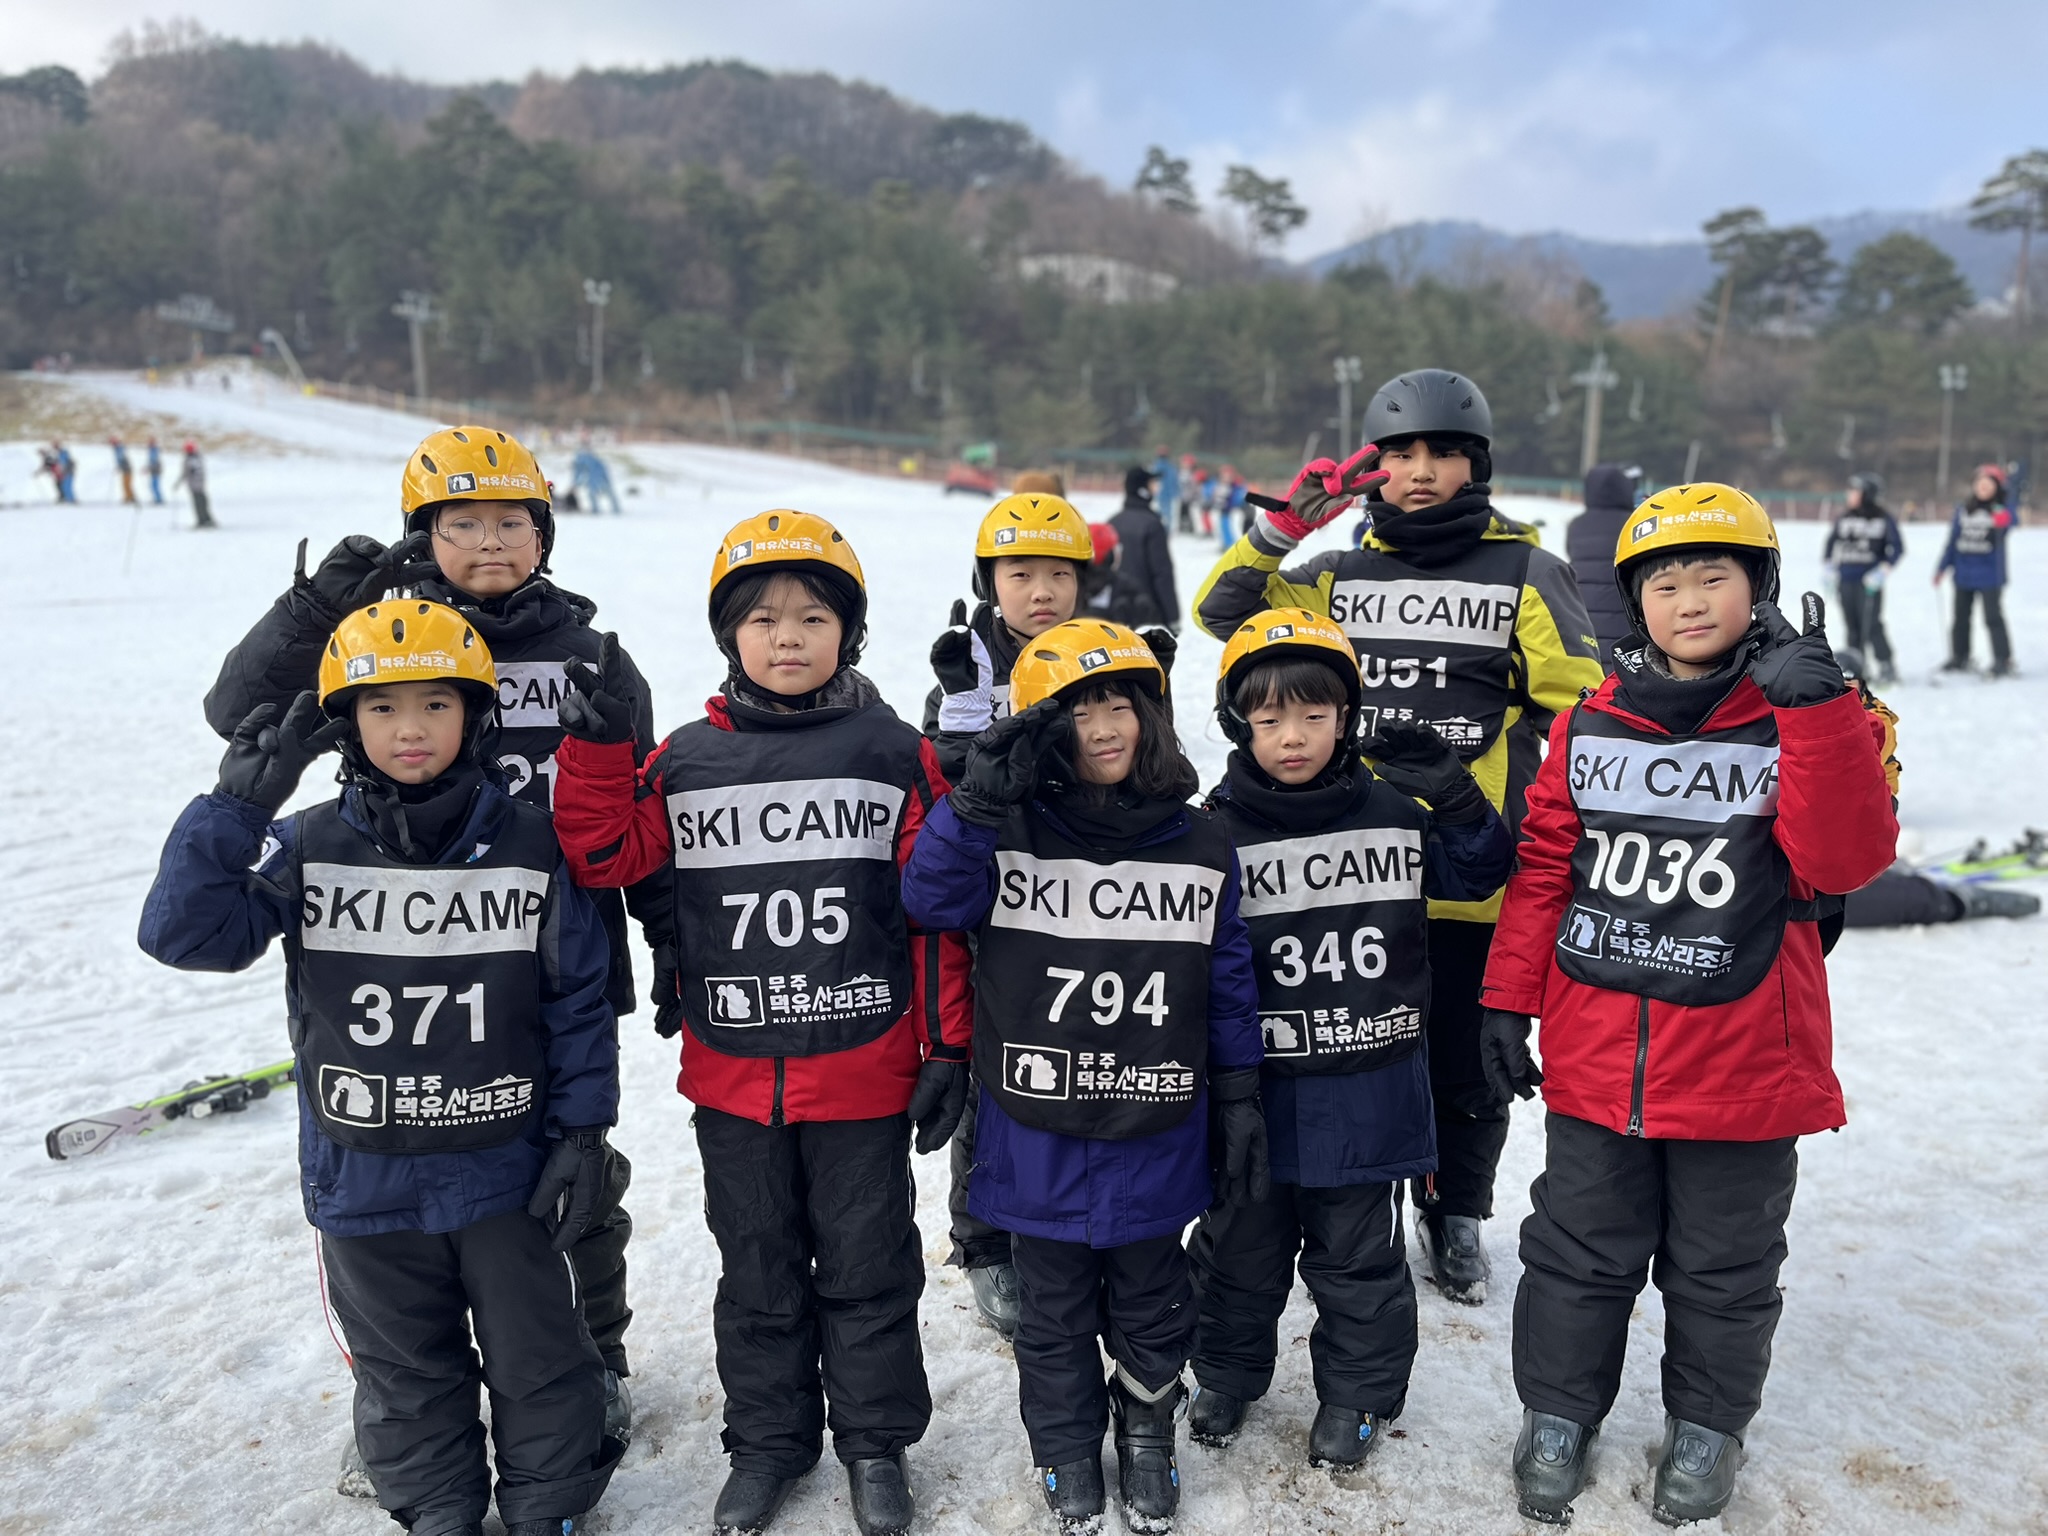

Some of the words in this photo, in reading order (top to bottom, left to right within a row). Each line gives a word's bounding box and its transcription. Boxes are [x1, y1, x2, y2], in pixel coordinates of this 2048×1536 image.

[1331, 594, 1386, 623] SKI
[1398, 594, 1515, 632] CAMP
[498, 677, 573, 710] CAM
[1571, 753, 1628, 792] SKI
[677, 806, 741, 850] SKI
[759, 799, 890, 842] CAMP
[1240, 859, 1287, 899] KI
[1303, 846, 1423, 890] CAMP
[303, 884, 387, 933] SKI
[403, 889, 545, 935] CAMP
[1001, 869, 1069, 918] SKI
[1089, 879, 1214, 923] CAMP
[722, 887, 849, 950] 705
[1270, 926, 1387, 987] 346
[1610, 955, 1632, 964] MUJU
[1638, 960, 1694, 976] DEOGYUSAN
[349, 983, 485, 1046] 371
[769, 984, 892, 1014] 덕유산리조트
[802, 1012, 857, 1022] DEOGYUSAN
[861, 1005, 892, 1016] RESORT
[1047, 966, 1169, 1026] 794
[1318, 1046, 1341, 1054] MUJU
[1346, 1039, 1393, 1051] DEOGYUSAN
[1077, 1066, 1194, 1093] 덕유산리조트
[1104, 1093, 1160, 1102] DEOGYUSAN
[430, 1114, 495, 1127] DEOGYUSAN
[500, 1104, 532, 1119] RESORT
